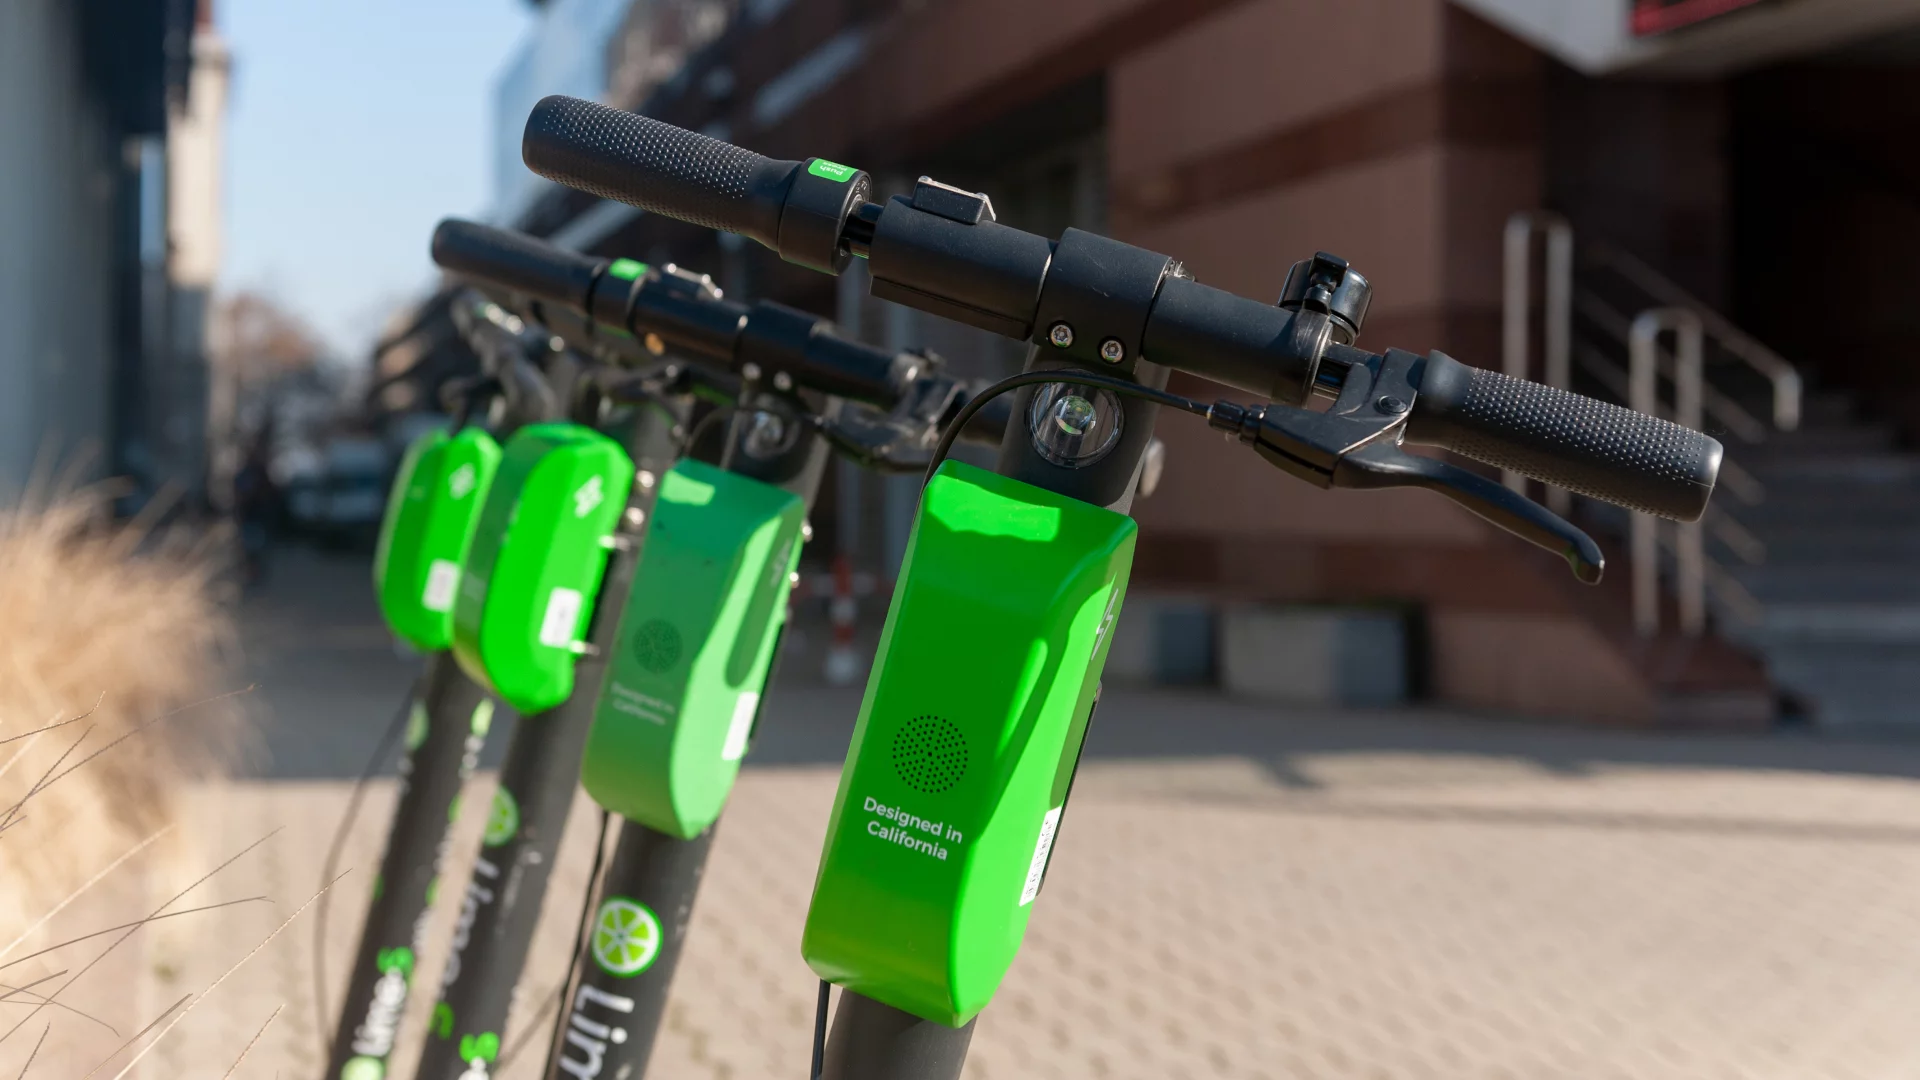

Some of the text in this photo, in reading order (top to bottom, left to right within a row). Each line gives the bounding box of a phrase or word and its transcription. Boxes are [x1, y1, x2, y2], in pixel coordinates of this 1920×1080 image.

[863, 796, 963, 844] Designed in
[867, 820, 948, 861] California
